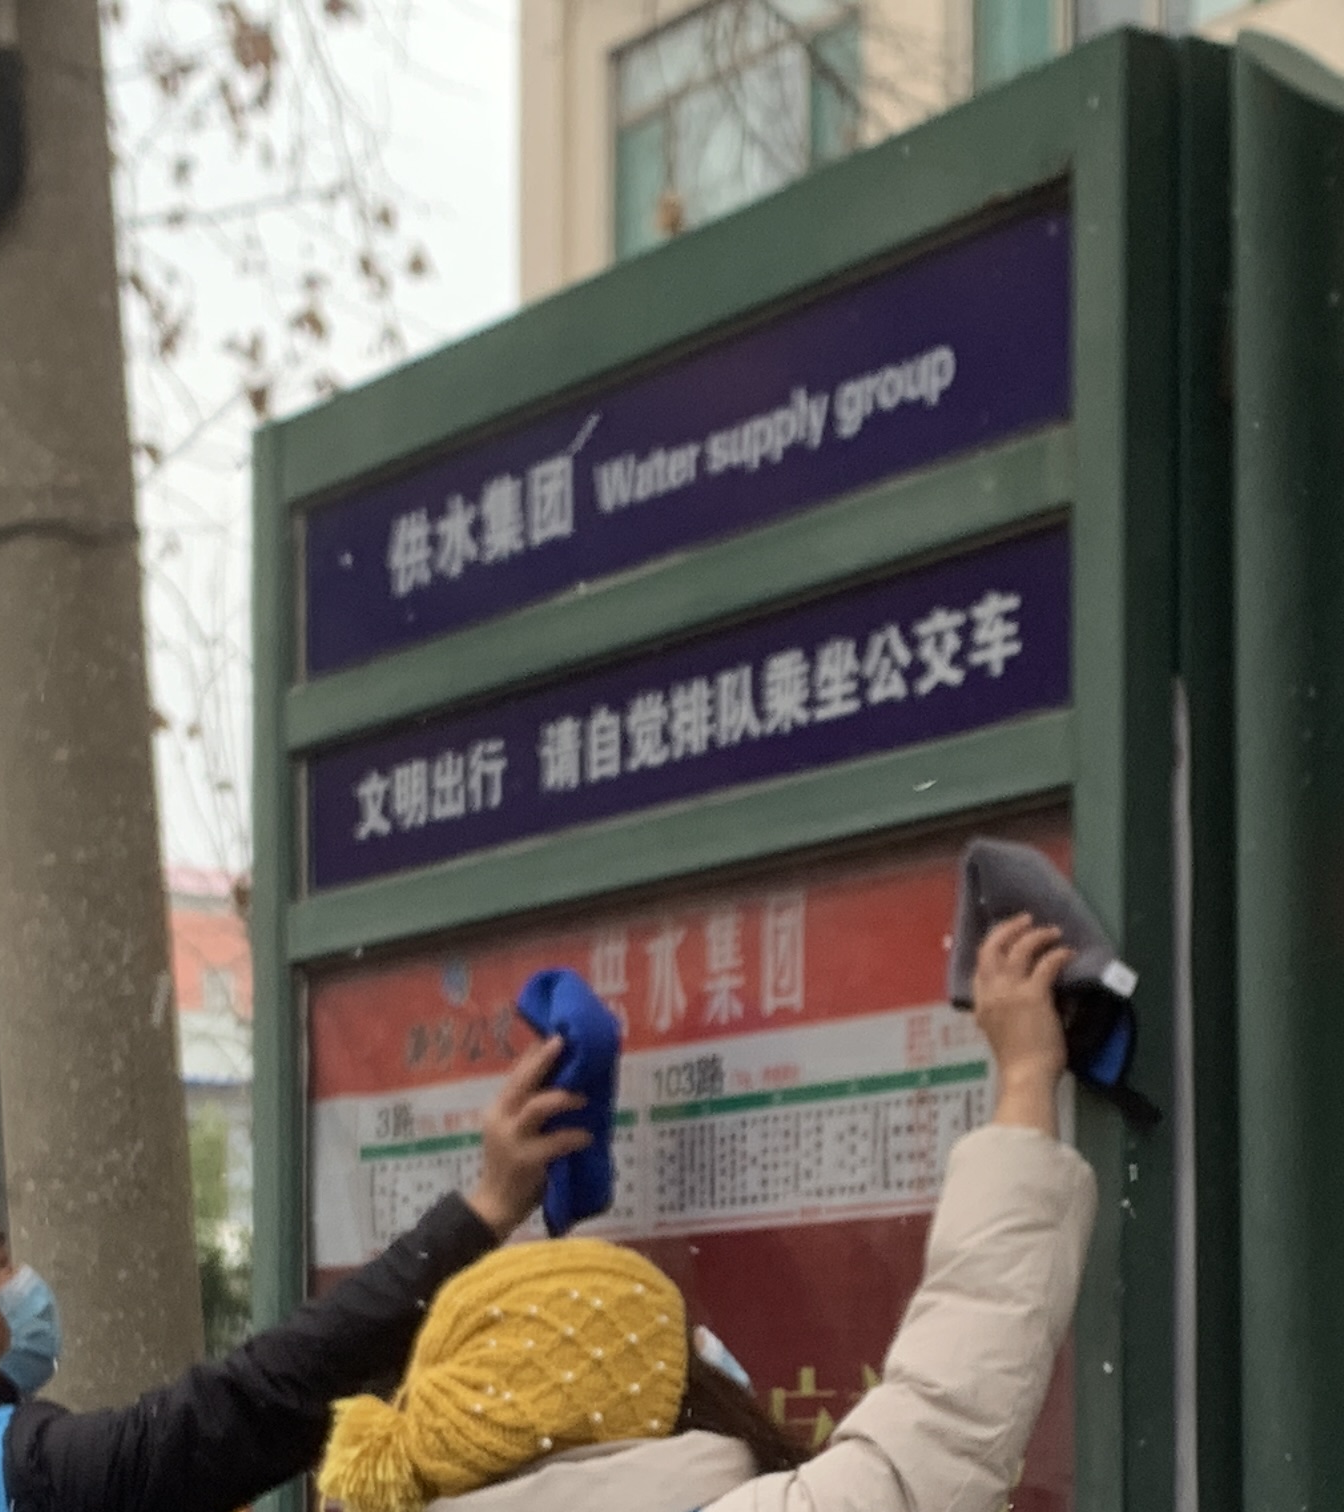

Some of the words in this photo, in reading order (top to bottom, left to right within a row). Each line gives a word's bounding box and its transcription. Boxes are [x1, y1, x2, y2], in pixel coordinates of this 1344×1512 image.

[387, 456, 573, 596] 供水集团
[594, 442, 700, 513] Water
[706, 386, 829, 474] supply
[833, 344, 956, 440] group
[355, 739, 507, 841] 文明出行
[537, 591, 1023, 793] 请自觉排队乘坐公交车
[652, 1053, 725, 1101] 103路
